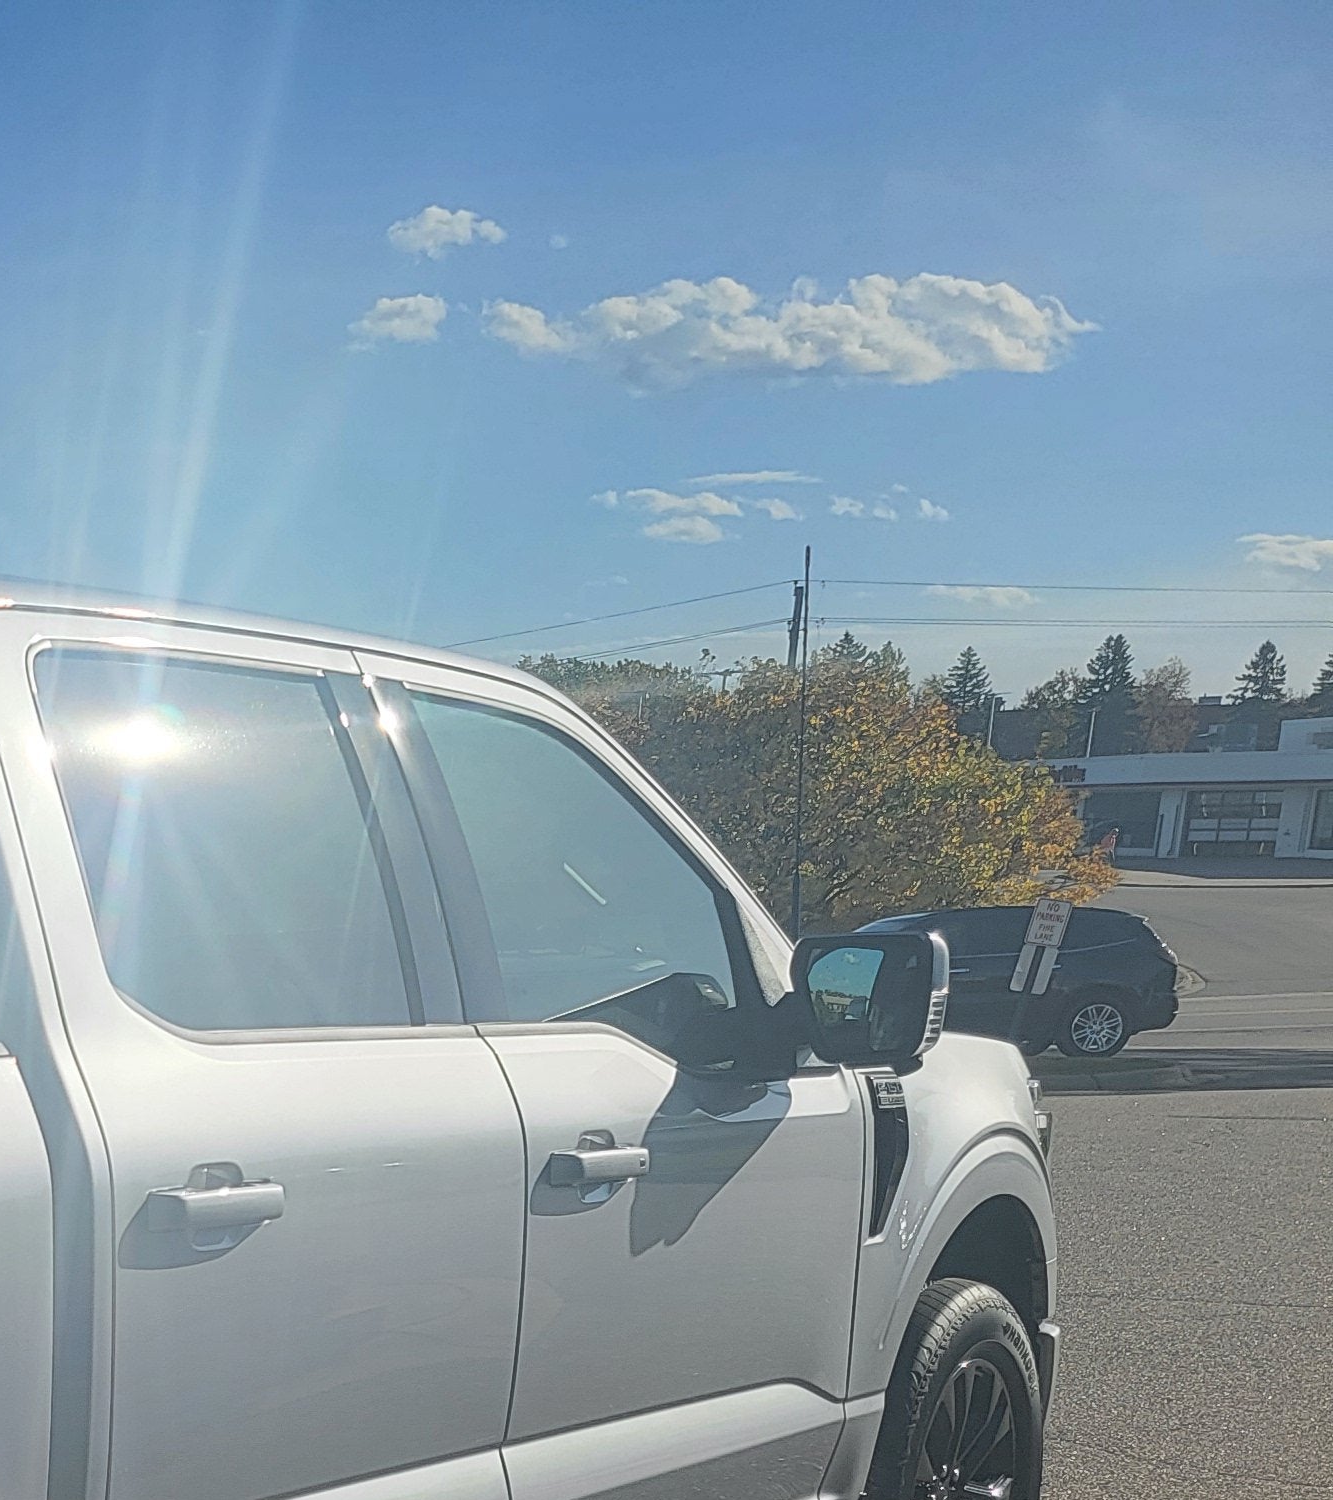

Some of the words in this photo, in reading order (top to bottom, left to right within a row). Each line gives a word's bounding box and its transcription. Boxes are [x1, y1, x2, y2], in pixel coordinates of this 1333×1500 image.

[1046, 903, 1060, 912] NO
[1036, 912, 1065, 923] PARKING
[1039, 923, 1054, 932] FIRE
[1035, 933, 1053, 942] LANE
